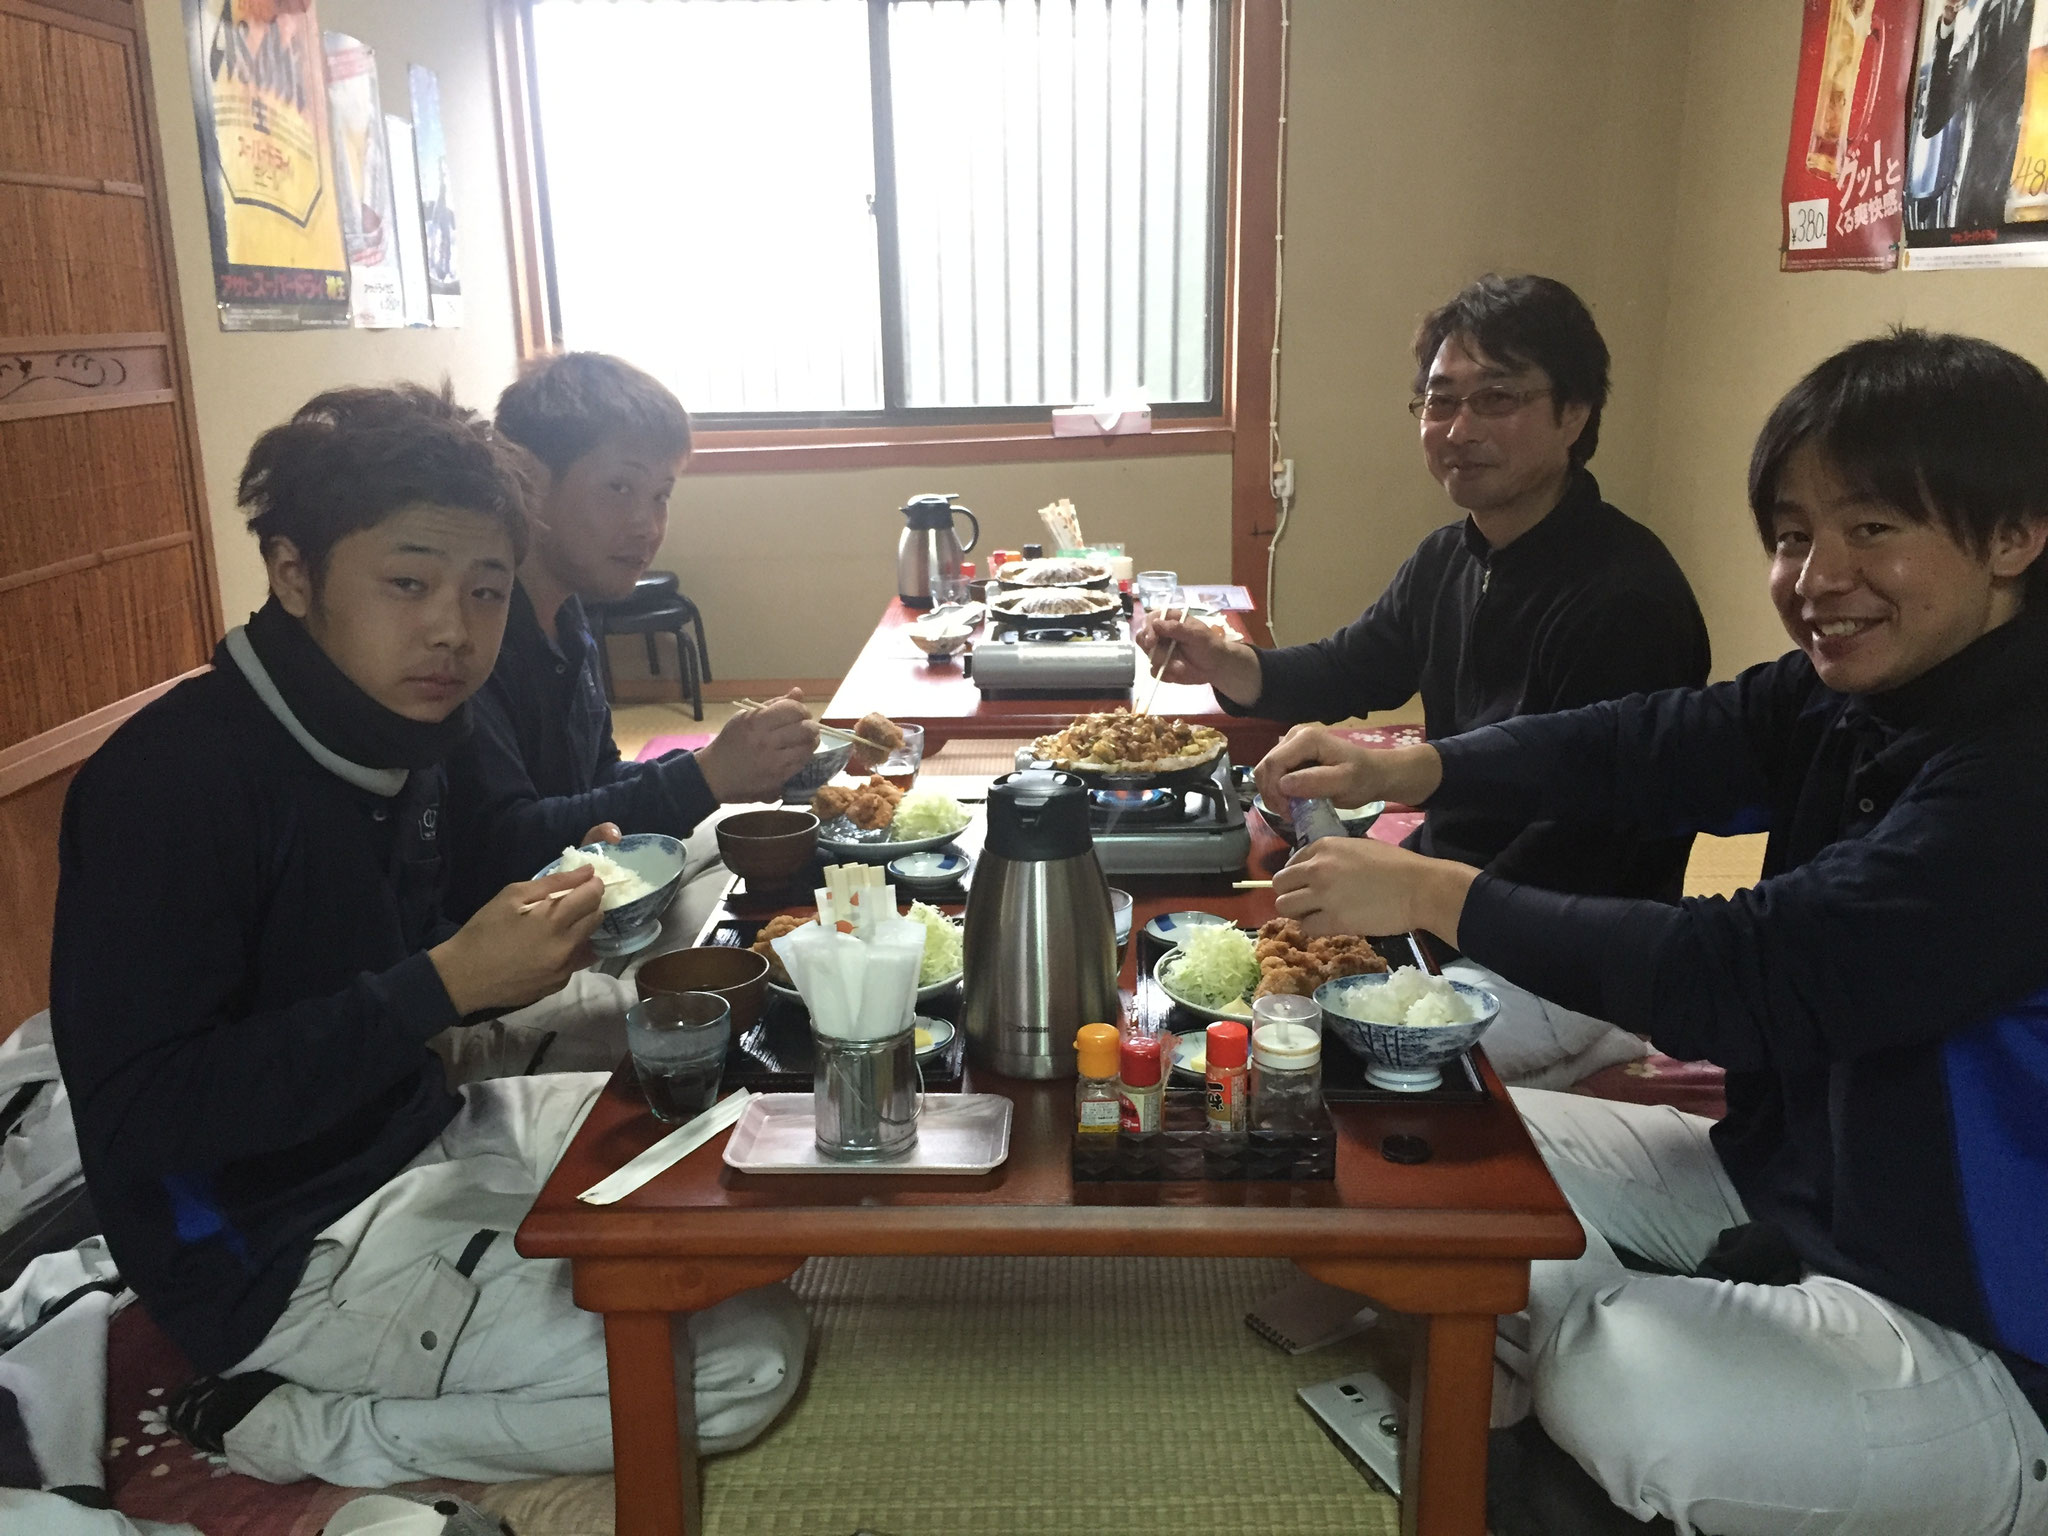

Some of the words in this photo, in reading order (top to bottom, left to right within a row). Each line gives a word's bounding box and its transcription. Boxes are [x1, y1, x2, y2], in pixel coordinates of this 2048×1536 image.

[1837, 139, 1901, 211] グッ!と
[2011, 156, 2048, 197] 48
